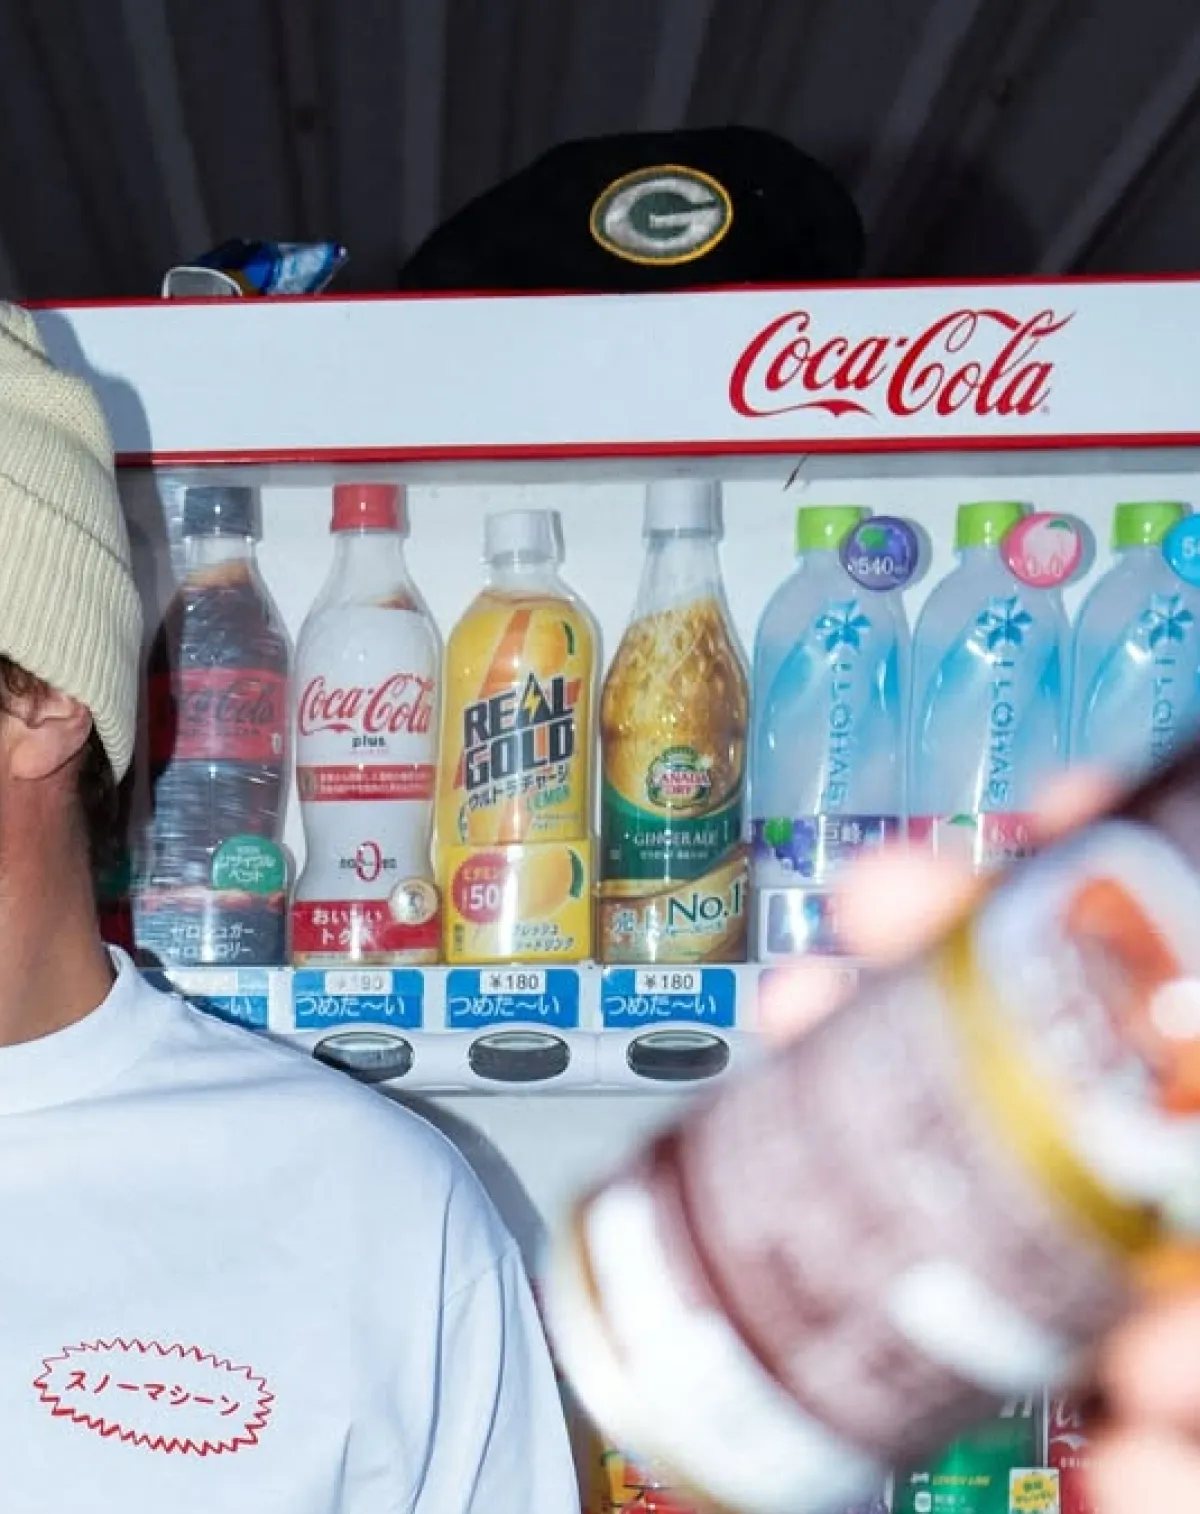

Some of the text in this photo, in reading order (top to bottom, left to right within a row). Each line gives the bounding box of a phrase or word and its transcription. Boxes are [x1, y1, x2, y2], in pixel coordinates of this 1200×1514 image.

[604, 176, 726, 251] G
[464, 673, 574, 749] REAL
[351, 735, 387, 749] plus
[465, 718, 574, 790] GOLD
[490, 972, 539, 992] ¥180
[644, 972, 694, 992] ¥180
[65, 1371, 240, 1416] スノーマシーン
